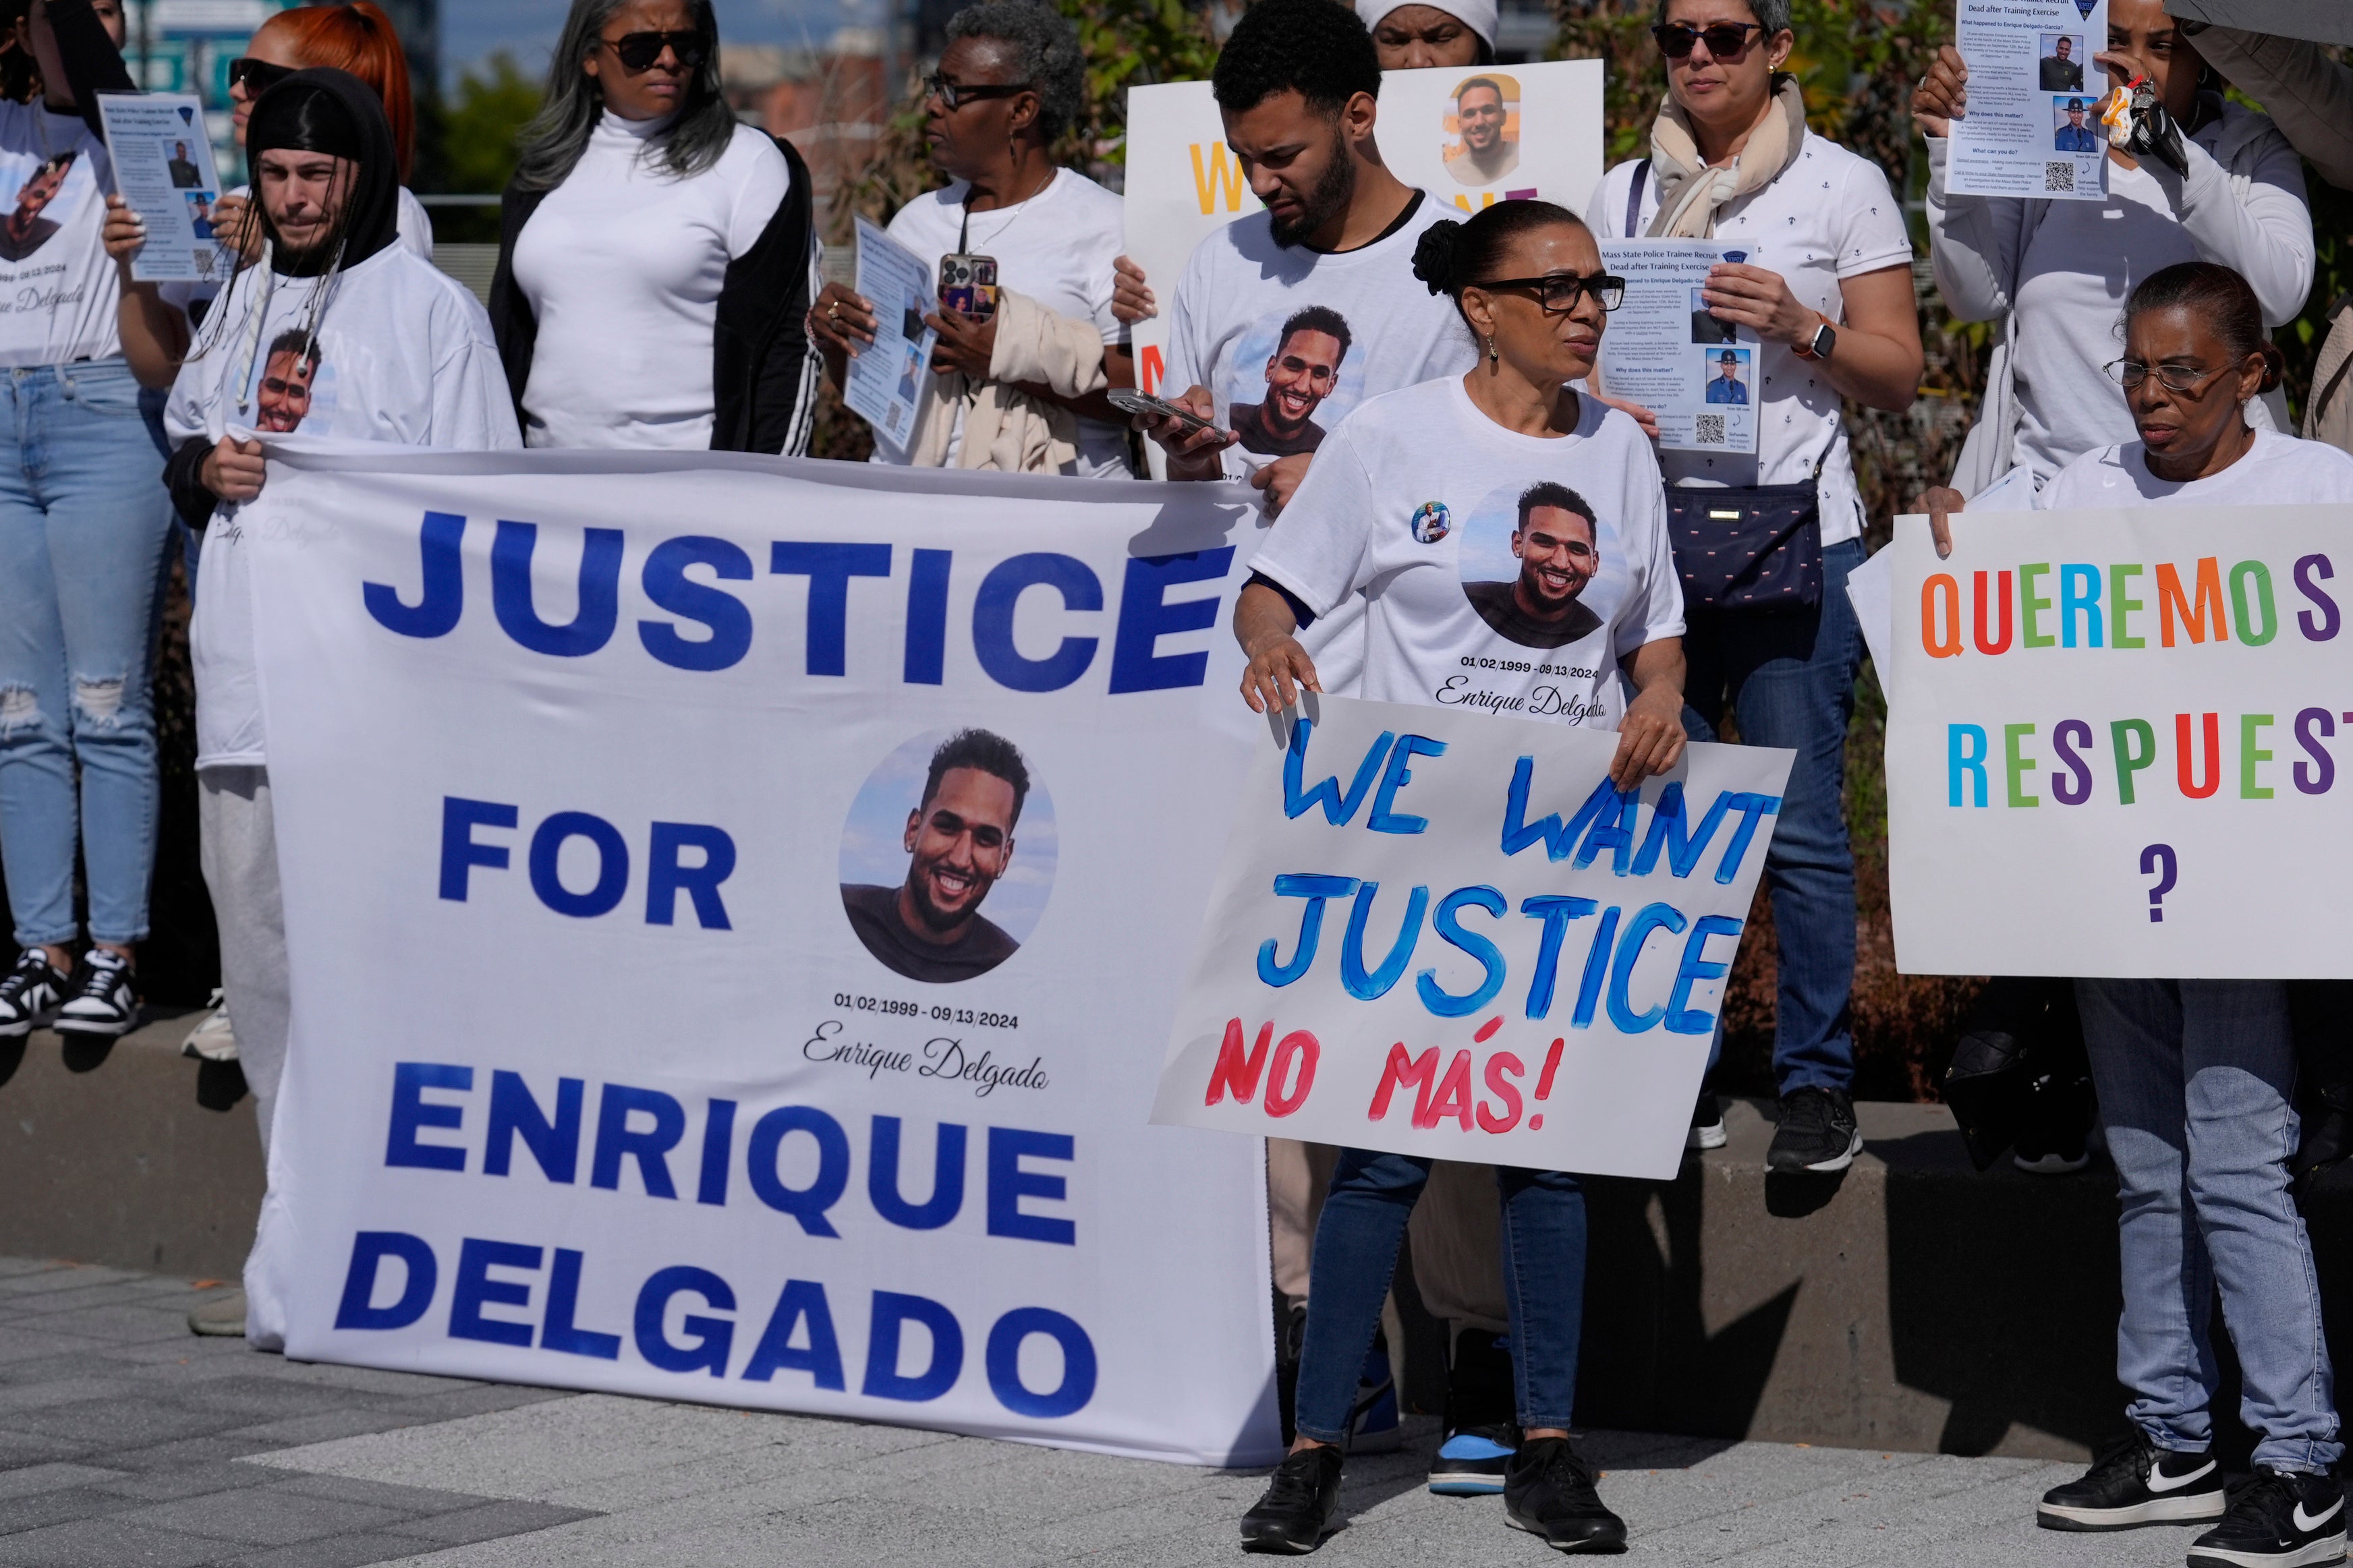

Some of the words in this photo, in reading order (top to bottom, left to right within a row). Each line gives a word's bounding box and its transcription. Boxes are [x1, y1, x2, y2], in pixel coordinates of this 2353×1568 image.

[2004, 7, 2031, 16] Training
[2033, 8, 2059, 16] Exercise
[1650, 263, 1680, 271] Training
[1695, 251, 1718, 259] Recruit
[363, 511, 1237, 695] JUSTICE
[1921, 553, 2341, 659] QUEREMOS
[1436, 675, 1525, 715] Enrique
[1529, 685, 1607, 726] Delgado
[1461, 656, 1531, 672] 01/02/1999
[1539, 664, 1599, 680] 09/13/2024
[1282, 717, 1449, 834] WE
[1500, 755, 1785, 885] WANT
[439, 796, 736, 930] FOR
[2140, 844, 2178, 923] ?
[1256, 872, 1745, 1035] JUSTICE
[834, 993, 918, 1016] 01/02/1999
[931, 1006, 1019, 1029] 09/13/2024
[803, 1020, 912, 1080] Enrique
[918, 1037, 1050, 1097] Delgado
[1205, 1016, 1320, 1118] NO
[1367, 1014, 1564, 1134] MÁS!
[385, 1062, 1075, 1245] ENRIQUE
[334, 1231, 1097, 1418] DELGADO
